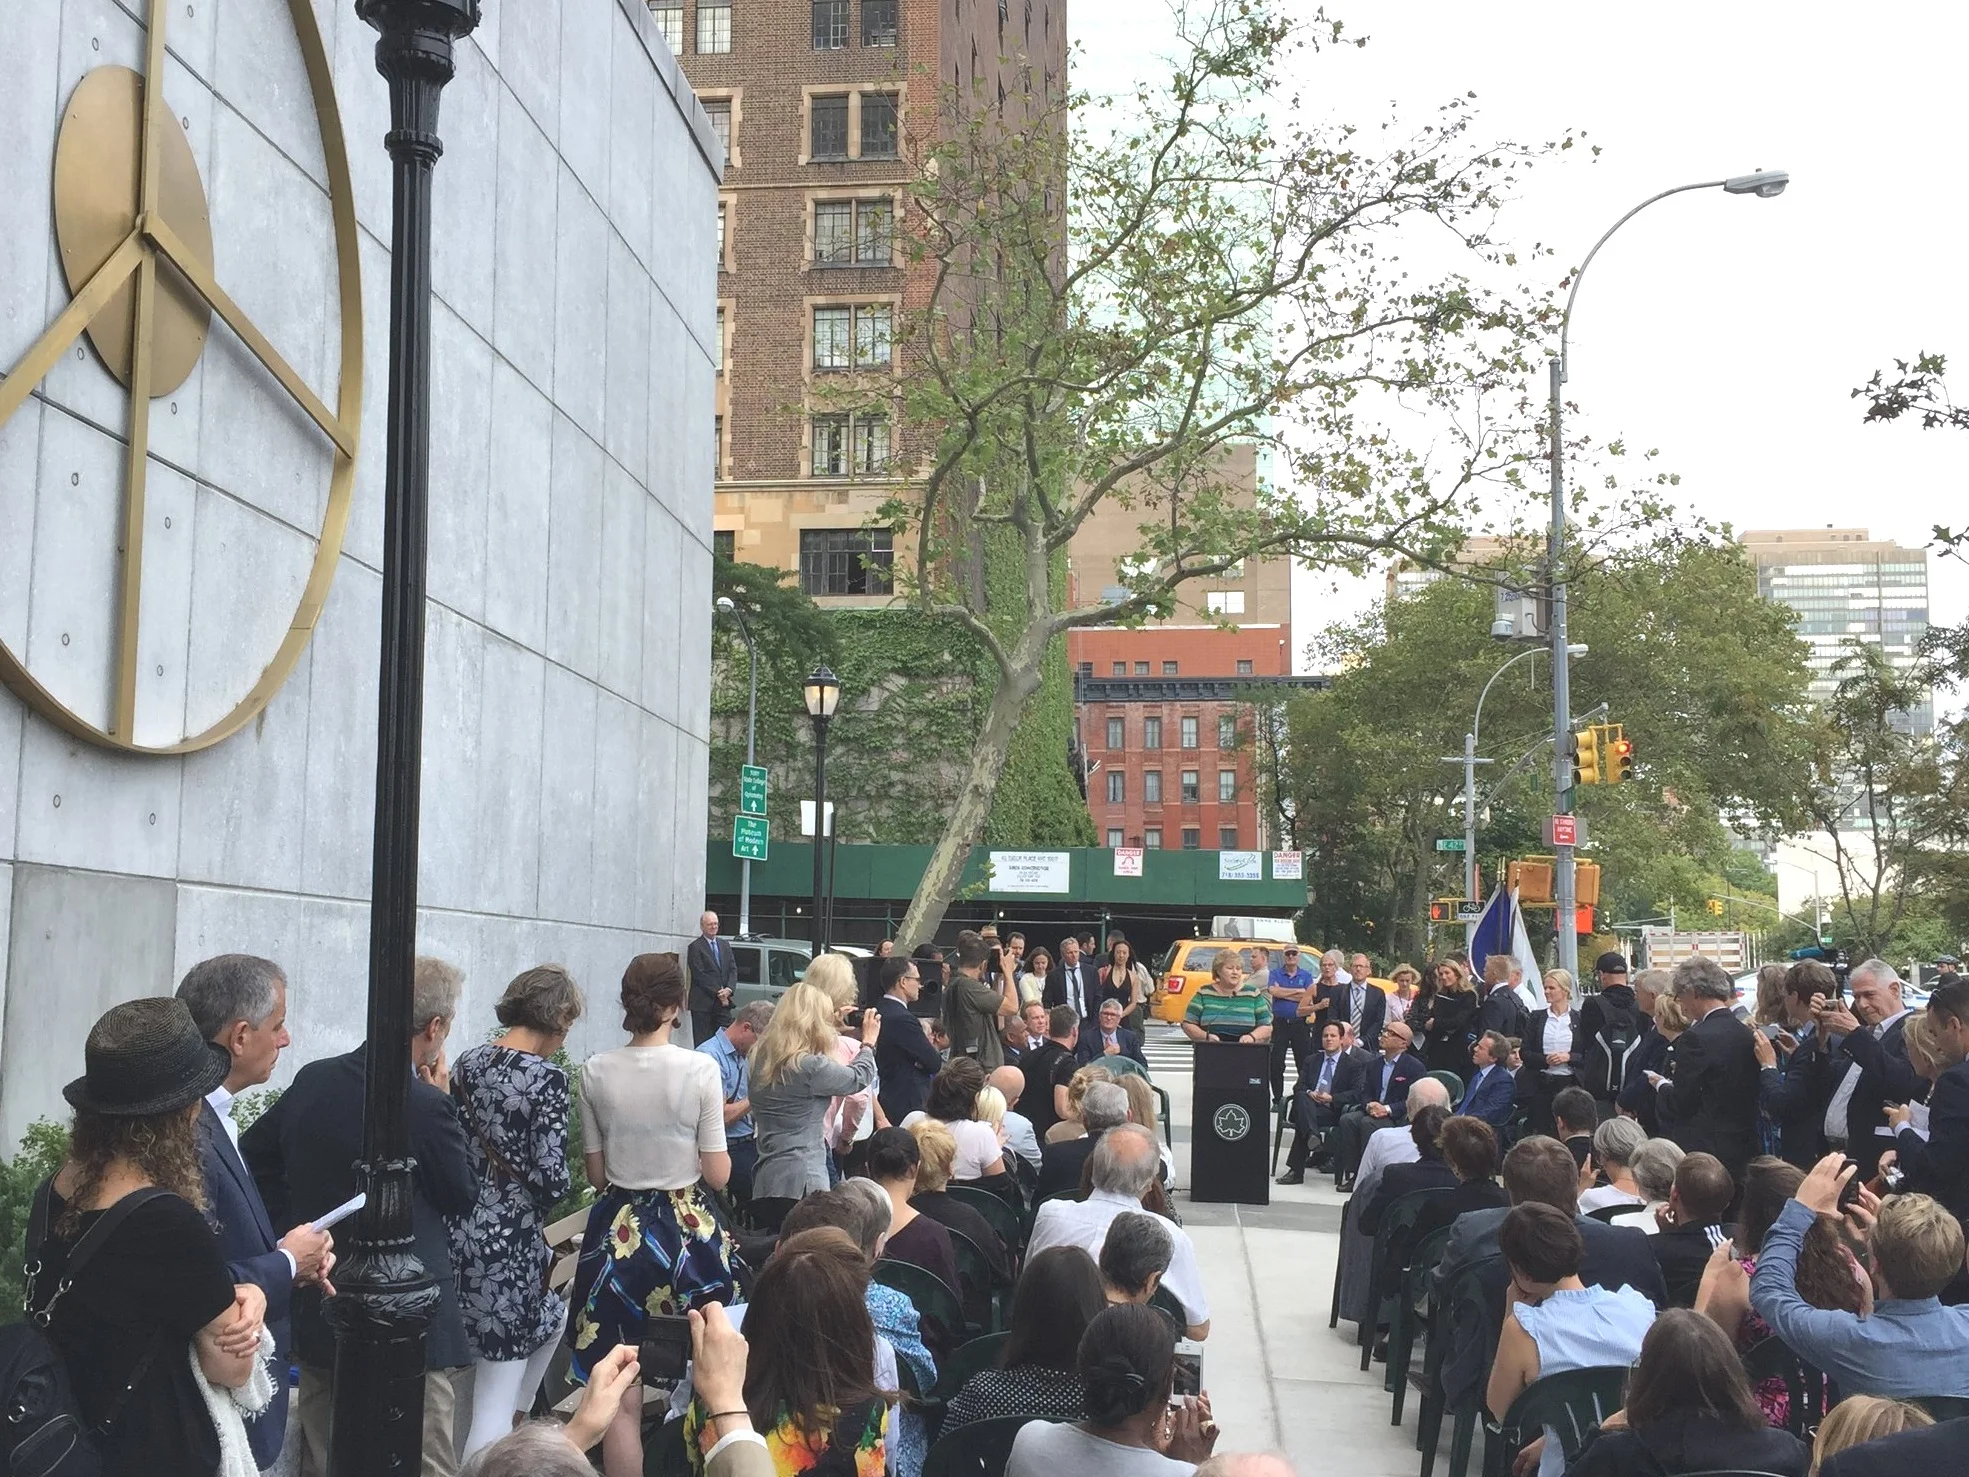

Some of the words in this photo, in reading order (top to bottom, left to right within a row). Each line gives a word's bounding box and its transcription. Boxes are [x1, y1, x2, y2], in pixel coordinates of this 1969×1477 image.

[747, 820, 757, 829] The
[740, 828, 762, 837] Museum
[745, 837, 764, 845] Modern
[740, 845, 750, 853] Art
